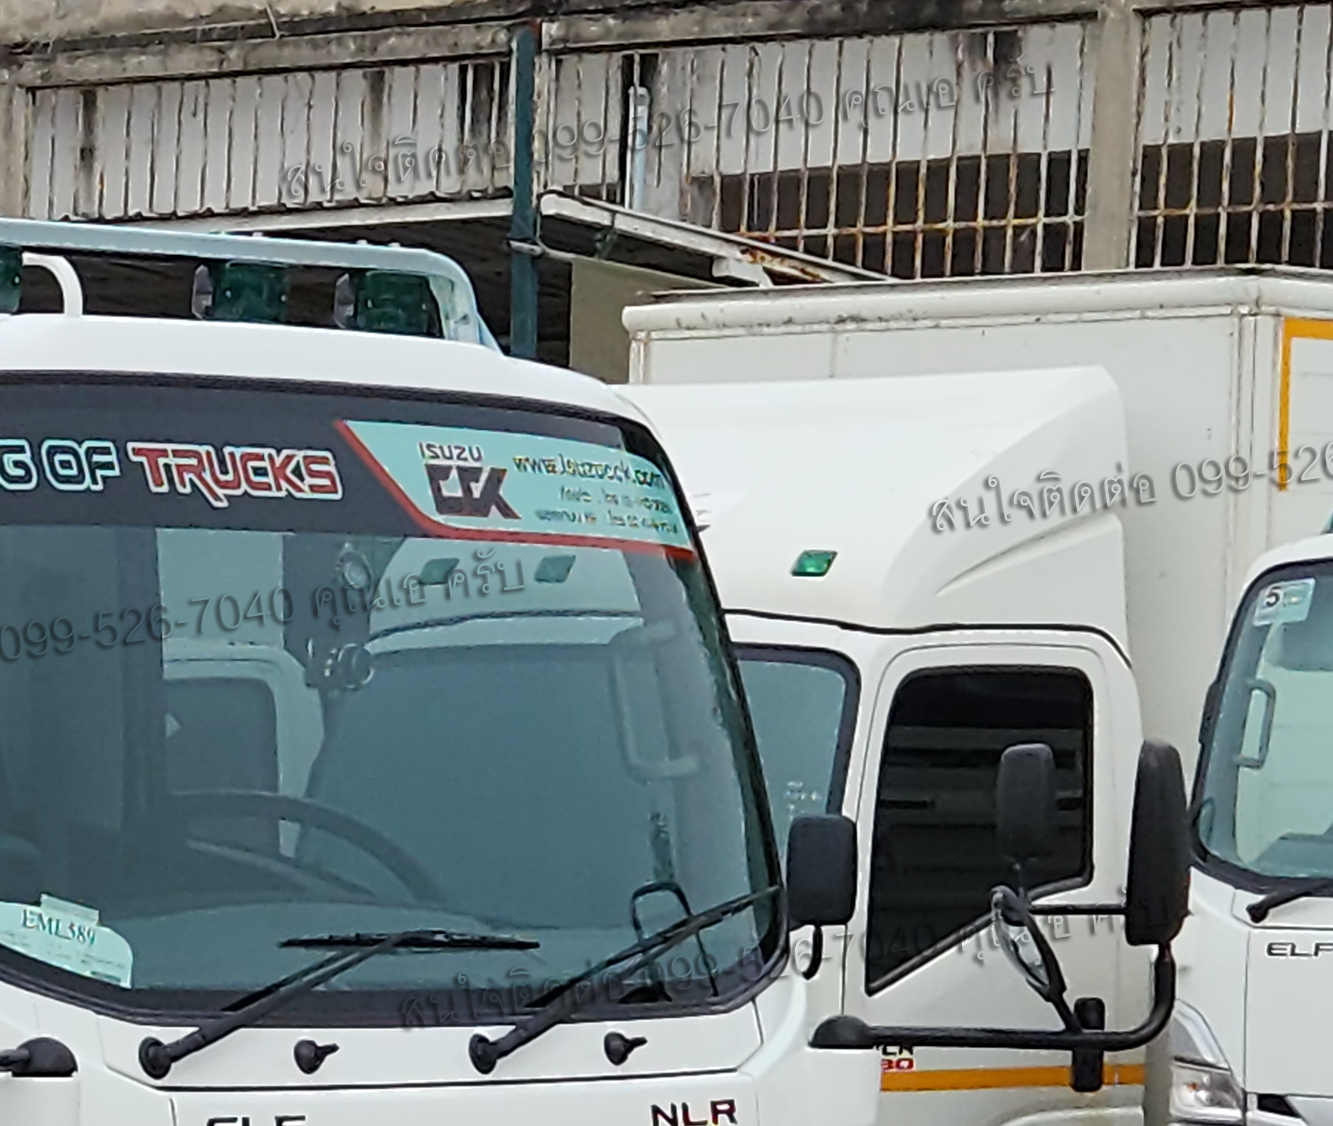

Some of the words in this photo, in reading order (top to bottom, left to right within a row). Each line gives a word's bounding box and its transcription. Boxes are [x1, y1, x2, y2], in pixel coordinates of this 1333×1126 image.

[418, 440, 483, 462] ISUZU
[40, 439, 121, 492] OF
[126, 441, 343, 508] TRUCKS
[1266, 942, 1333, 958] ELF
